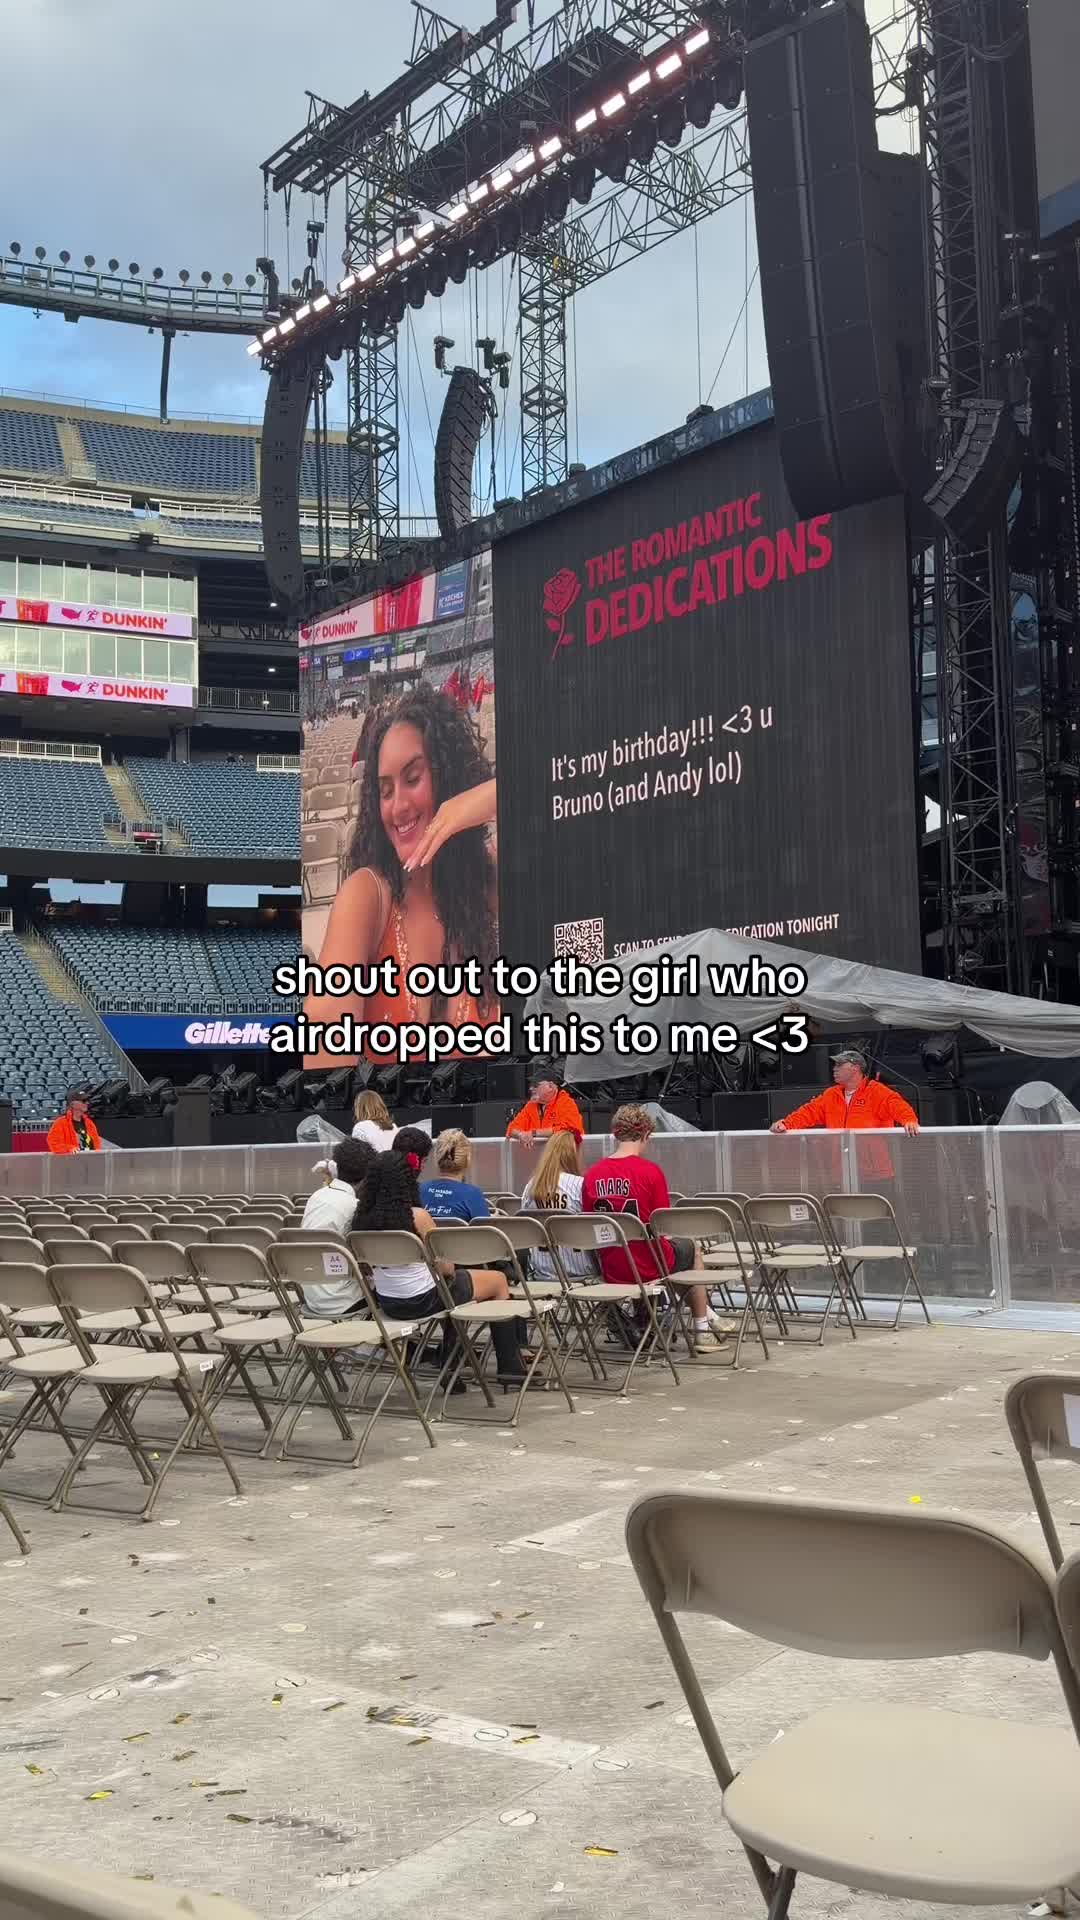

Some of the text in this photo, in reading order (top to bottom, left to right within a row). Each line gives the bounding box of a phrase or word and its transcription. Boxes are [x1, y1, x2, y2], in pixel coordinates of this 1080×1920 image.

[585, 492, 762, 589] THE ROMANTIC
[585, 513, 832, 647] DEDICATIONS
[102, 611, 168, 630] DUNKIN'
[322, 620, 358, 638] DUNKIN'
[102, 683, 168, 701] DUNKIN'
[551, 704, 773, 782] It's my birthday!!! <3 u
[552, 750, 743, 820] Bruno (and Andy lol)
[787, 913, 840, 935] TONIGHT
[184, 1021, 273, 1045] Gillette
[596, 1178, 630, 1199] MARS
